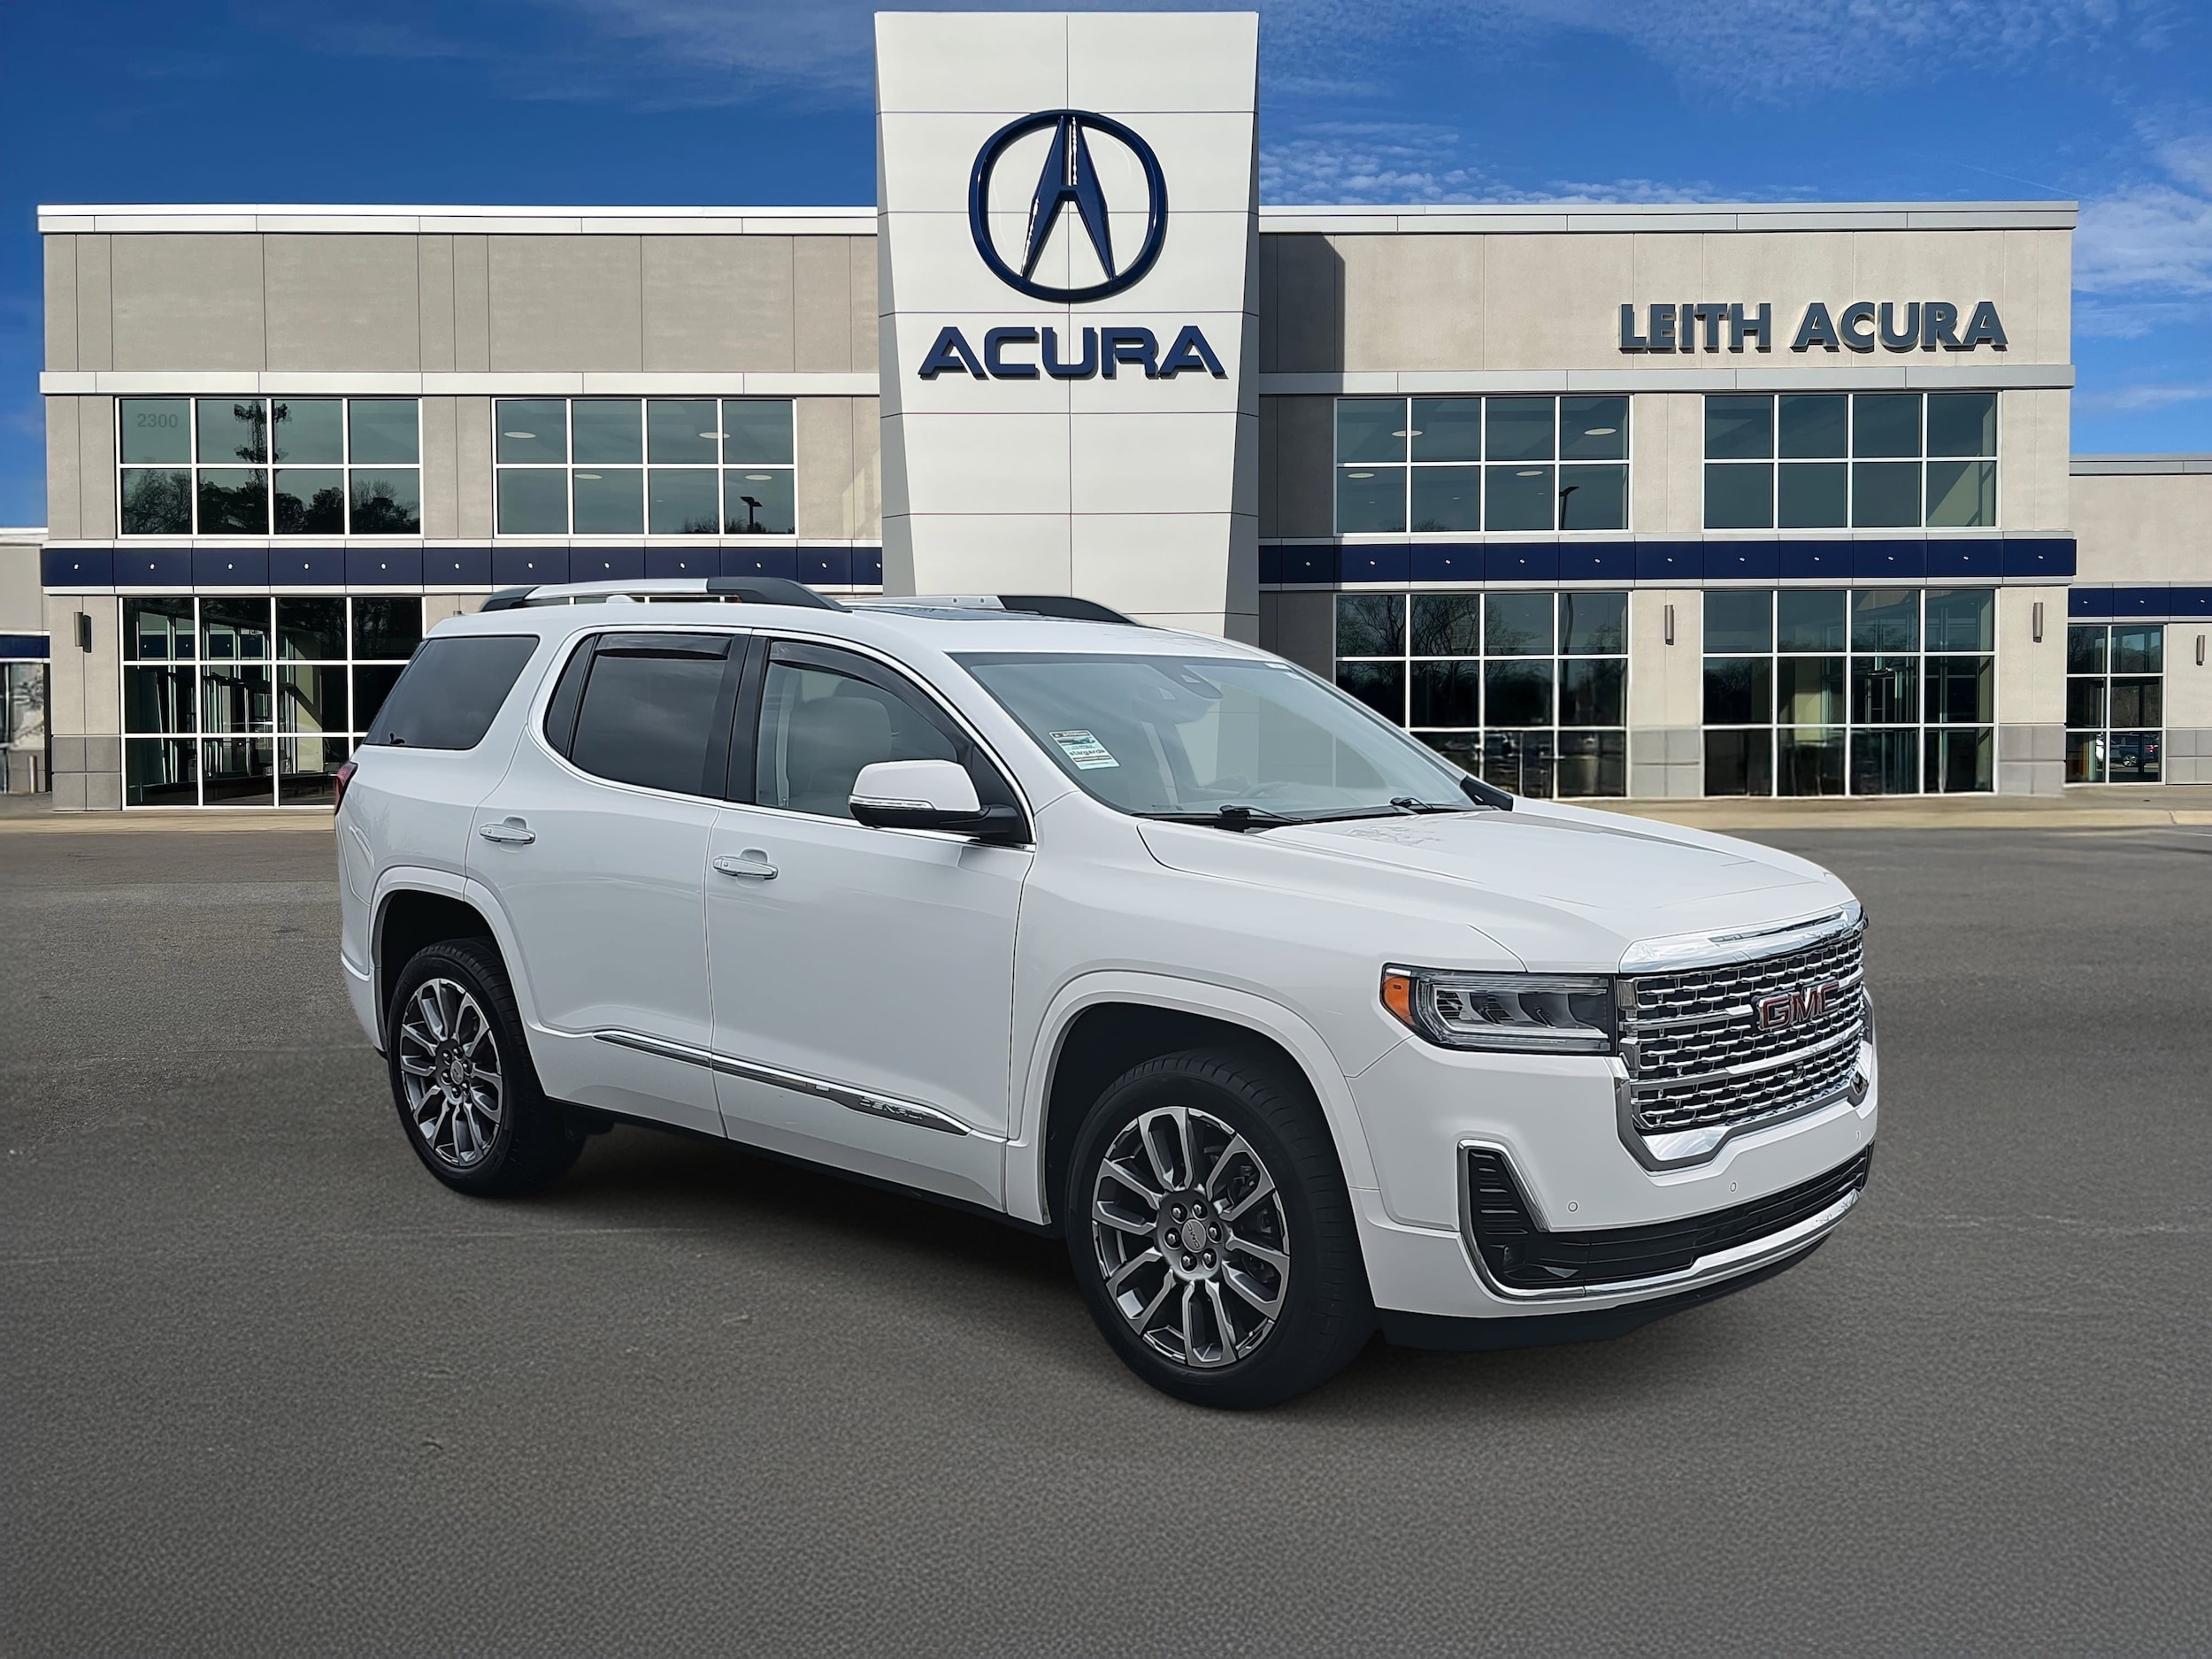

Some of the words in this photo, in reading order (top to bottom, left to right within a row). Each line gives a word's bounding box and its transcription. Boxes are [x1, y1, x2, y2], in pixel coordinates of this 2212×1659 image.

[918, 326, 1228, 380] ACURA
[1618, 303, 1771, 353] LEITH
[1789, 301, 2008, 353] ACURA
[136, 412, 179, 428] 2300
[1757, 979, 1839, 1032] GMC
